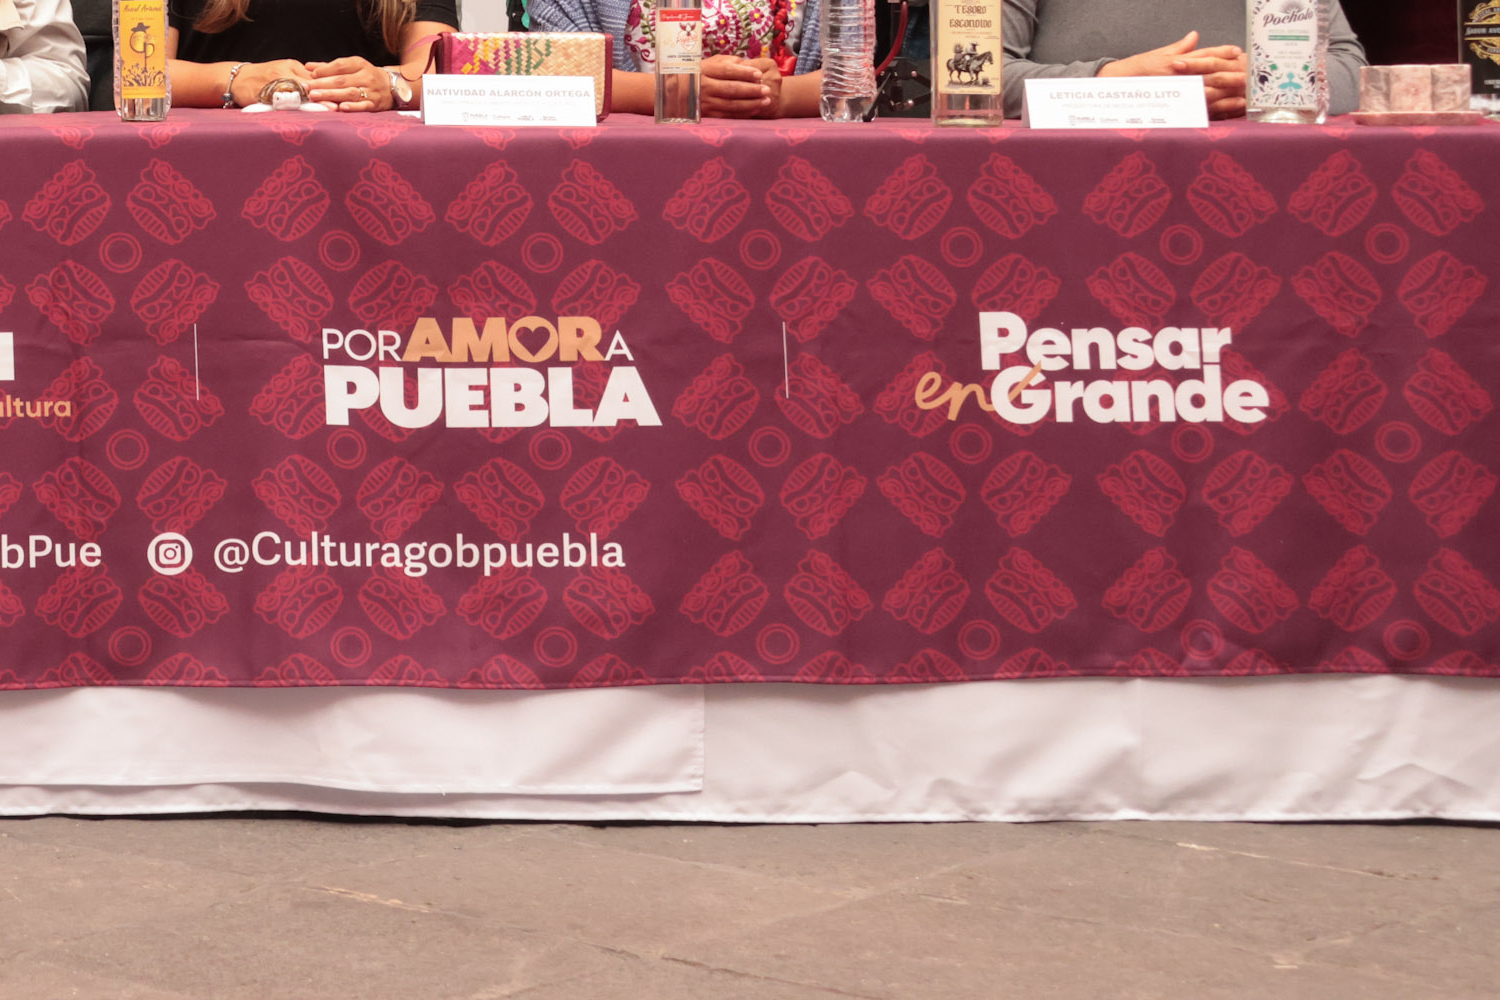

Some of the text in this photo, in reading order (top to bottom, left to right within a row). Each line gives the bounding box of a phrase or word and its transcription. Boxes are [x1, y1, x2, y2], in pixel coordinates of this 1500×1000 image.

[949, 19, 992, 28] ESCONDIDO
[955, 5, 986, 14] TESORO
[1263, 8, 1313, 28] Pocholo
[427, 89, 486, 97] NATIVIDAD
[1050, 89, 1180, 99] LETICIA CASTAÑO LITO
[322, 316, 634, 362] POR AMOR A
[979, 311, 1232, 370] Pensar
[324, 365, 662, 428] PUEBLA
[915, 365, 1269, 424] en Grande
[214, 531, 625, 577] @Culturagobpuebla
